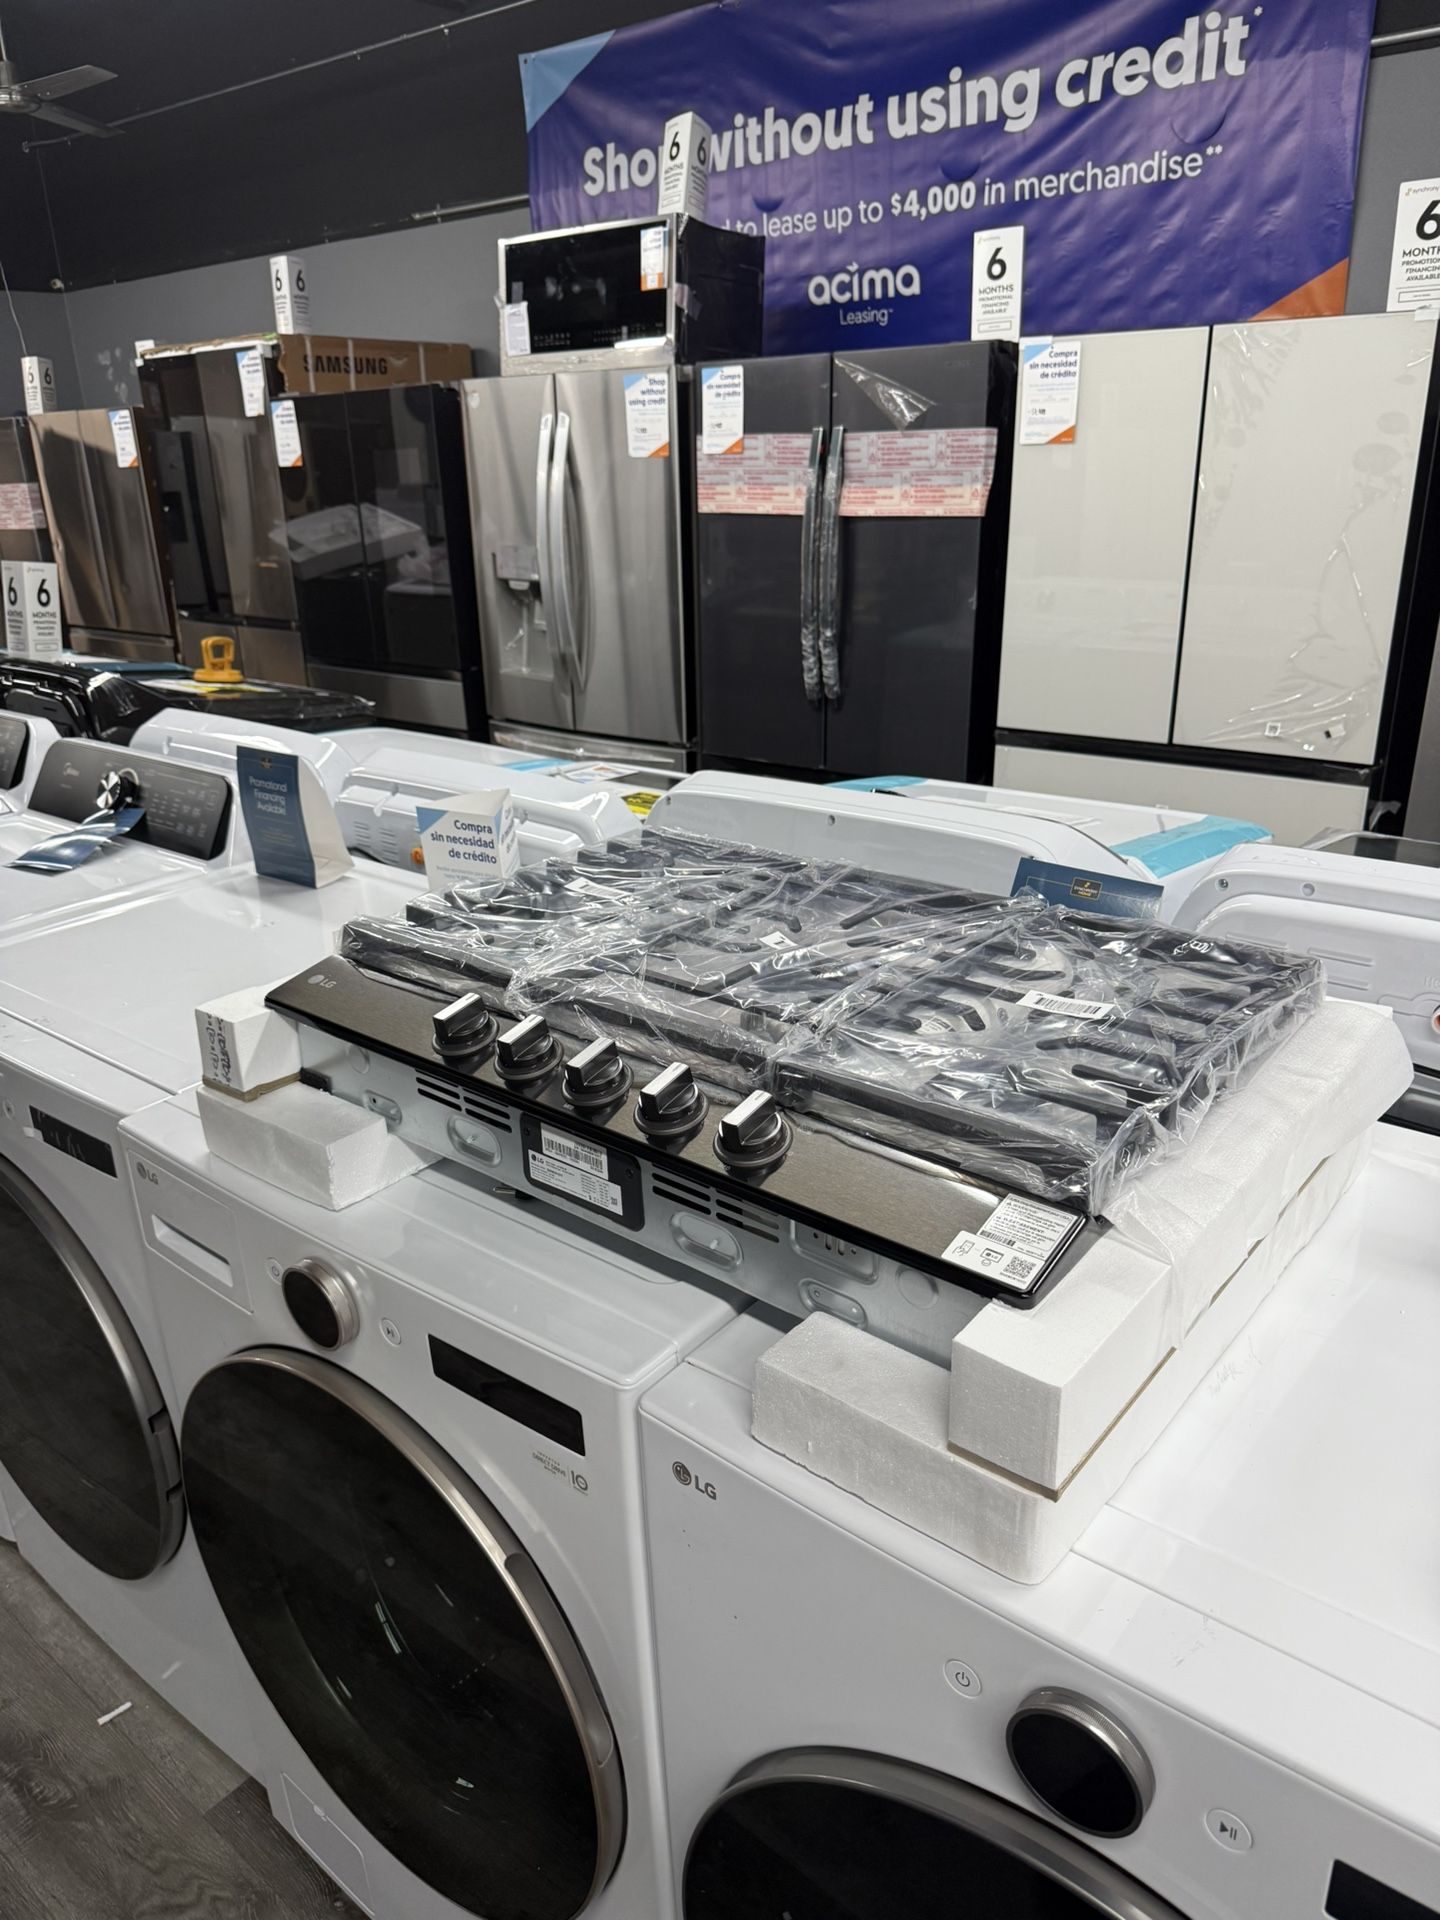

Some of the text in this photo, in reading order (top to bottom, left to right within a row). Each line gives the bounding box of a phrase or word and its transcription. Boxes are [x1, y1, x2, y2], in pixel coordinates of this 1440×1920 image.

[583, 142, 664, 196] Sho
[708, 93, 874, 173] without
[887, 67, 1041, 132] using
[669, 131, 680, 160] 6
[697, 137, 707, 165] 6
[763, 213, 817, 237] lease
[823, 207, 852, 233] up
[859, 200, 883, 223] to
[891, 181, 976, 221] $4,000
[984, 178, 1006, 206] in
[1416, 199, 1440, 241] 6
[987, 246, 1007, 280] 6
[275, 269, 283, 292] 6
[296, 269, 306, 292] 6
[808, 262, 920, 305] acima
[978, 284, 1014, 295] MONTHS
[304, 355, 388, 375] SAMSUNG
[1041, 360, 1077, 369] necesidad
[1049, 350, 1077, 359] Compra
[28, 367, 34, 384] 6
[44, 368, 52, 385] 6
[8, 577, 18, 606] 6
[37, 578, 51, 607] 6
[454, 819, 493, 835] Compra
[431, 831, 495, 849] sin necesidad
[448, 848, 497, 864] de crédito
[320, 978, 336, 989] LG
[147, 1169, 158, 1185] LG
[695, 1474, 716, 1500] LG
